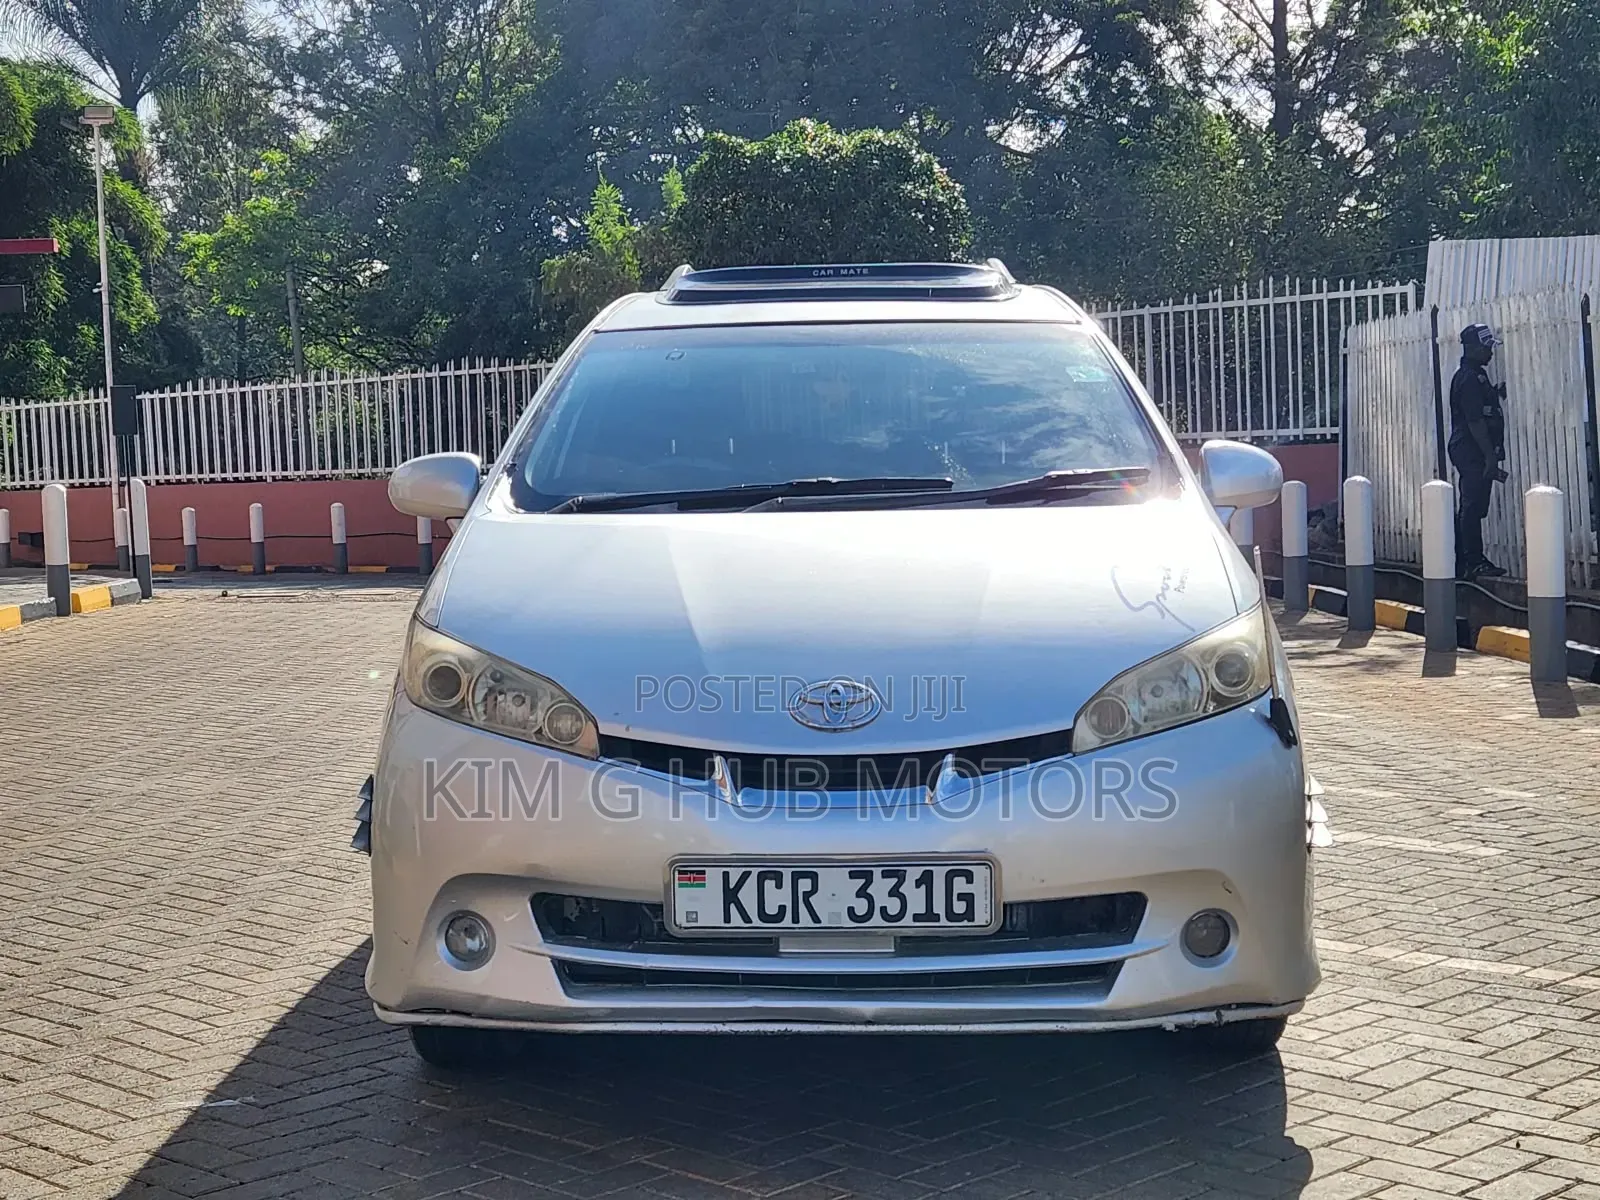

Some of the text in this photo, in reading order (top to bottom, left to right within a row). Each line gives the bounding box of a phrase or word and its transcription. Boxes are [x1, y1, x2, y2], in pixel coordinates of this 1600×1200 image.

[812, 269, 834, 277] CAR
[722, 870, 822, 924] KCR
[847, 869, 975, 924] 331G
